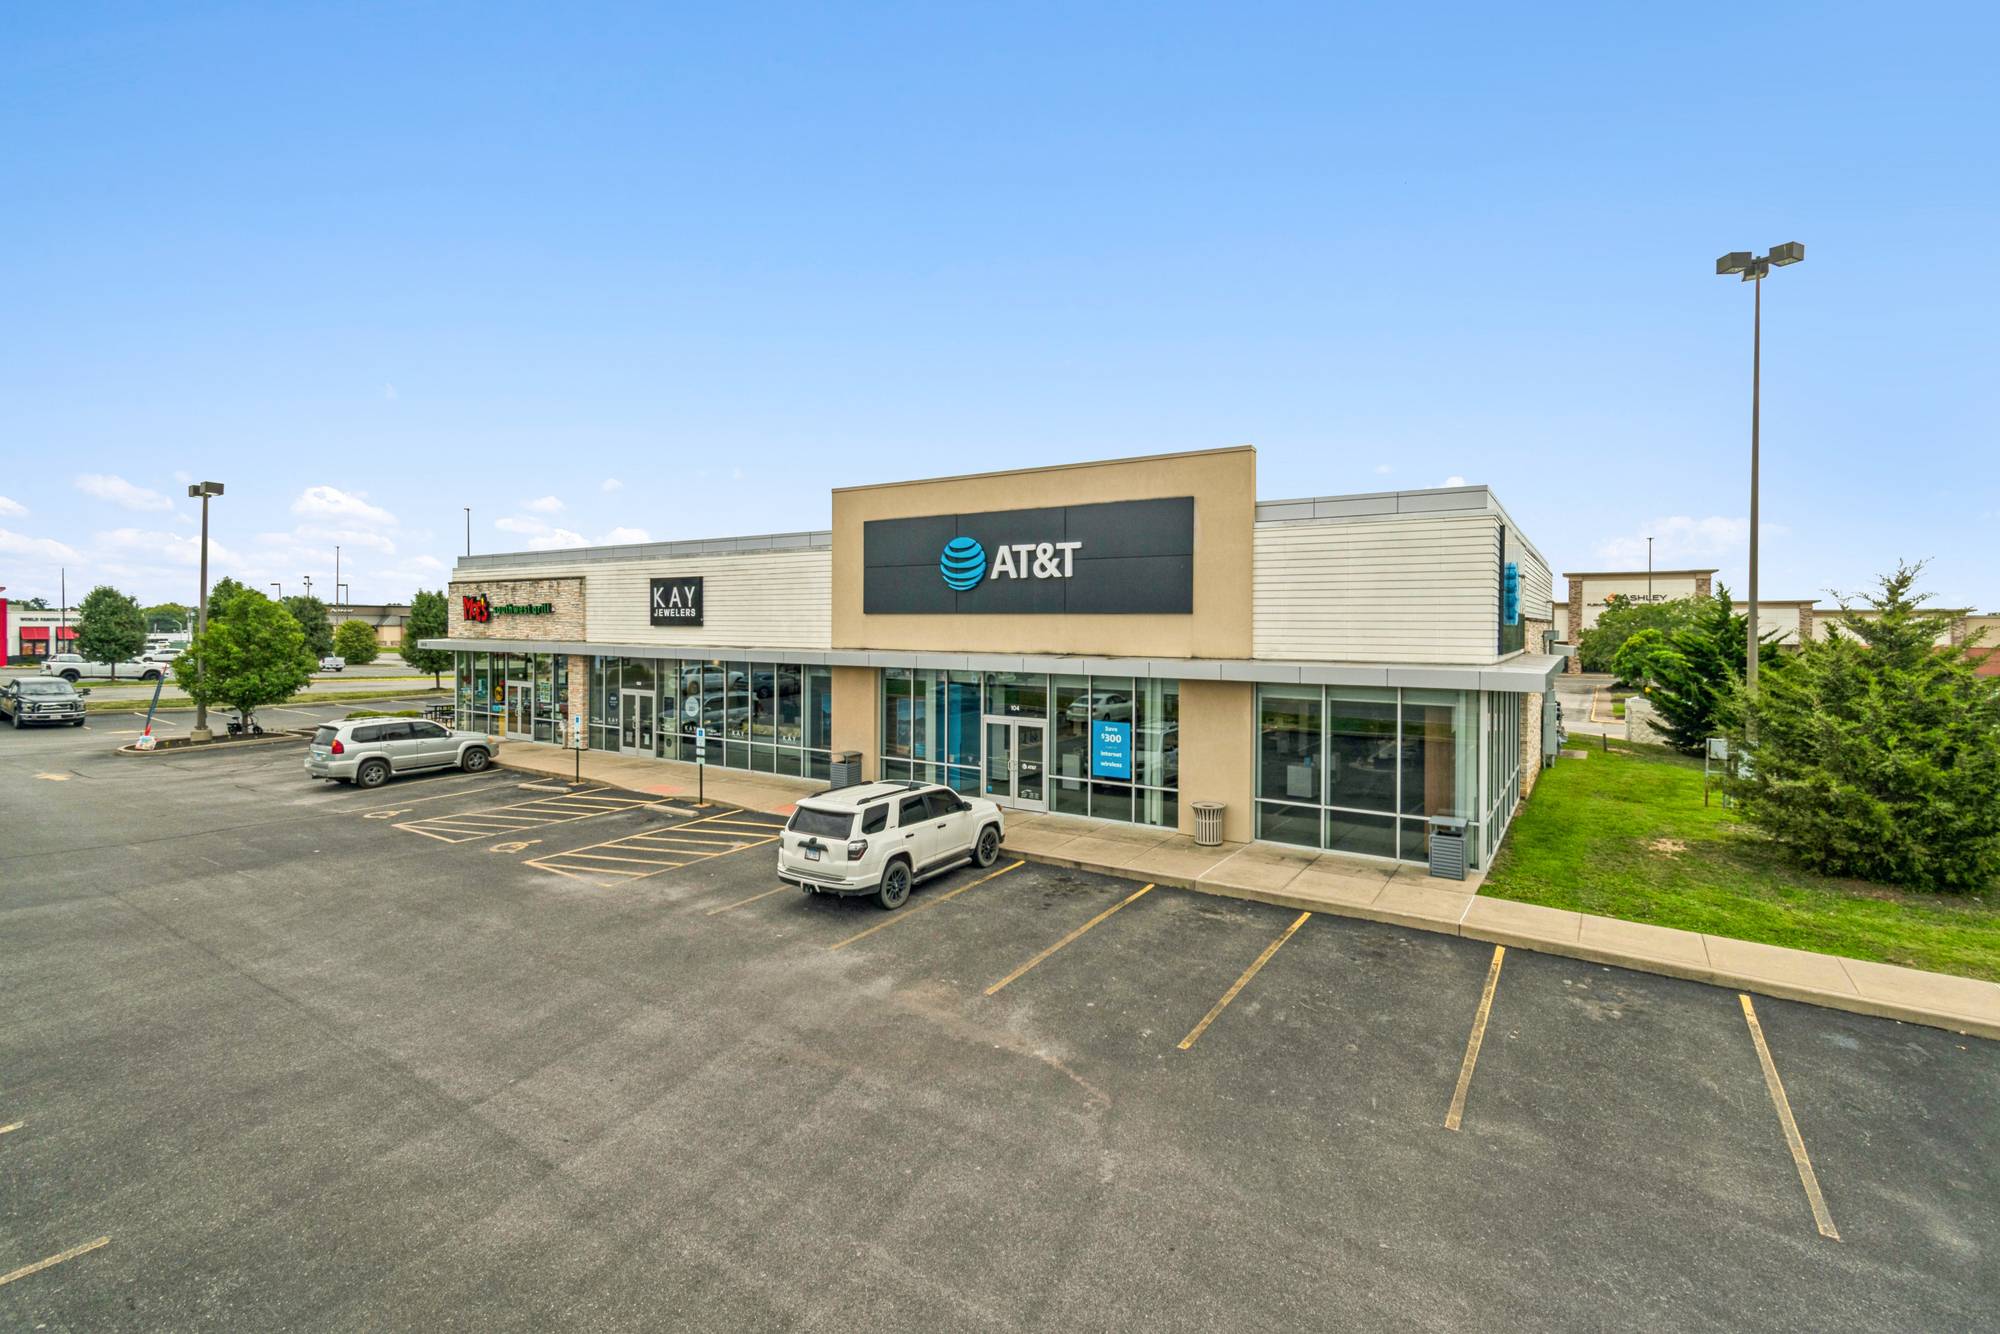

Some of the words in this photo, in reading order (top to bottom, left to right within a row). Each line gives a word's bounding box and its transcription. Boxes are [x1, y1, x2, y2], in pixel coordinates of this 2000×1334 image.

[990, 541, 1082, 580] AT&T
[653, 586, 696, 608] KAY
[1622, 594, 1668, 602] ASHLEY
[653, 608, 696, 617] JEWELERS
[1100, 733, 1122, 743] $300
